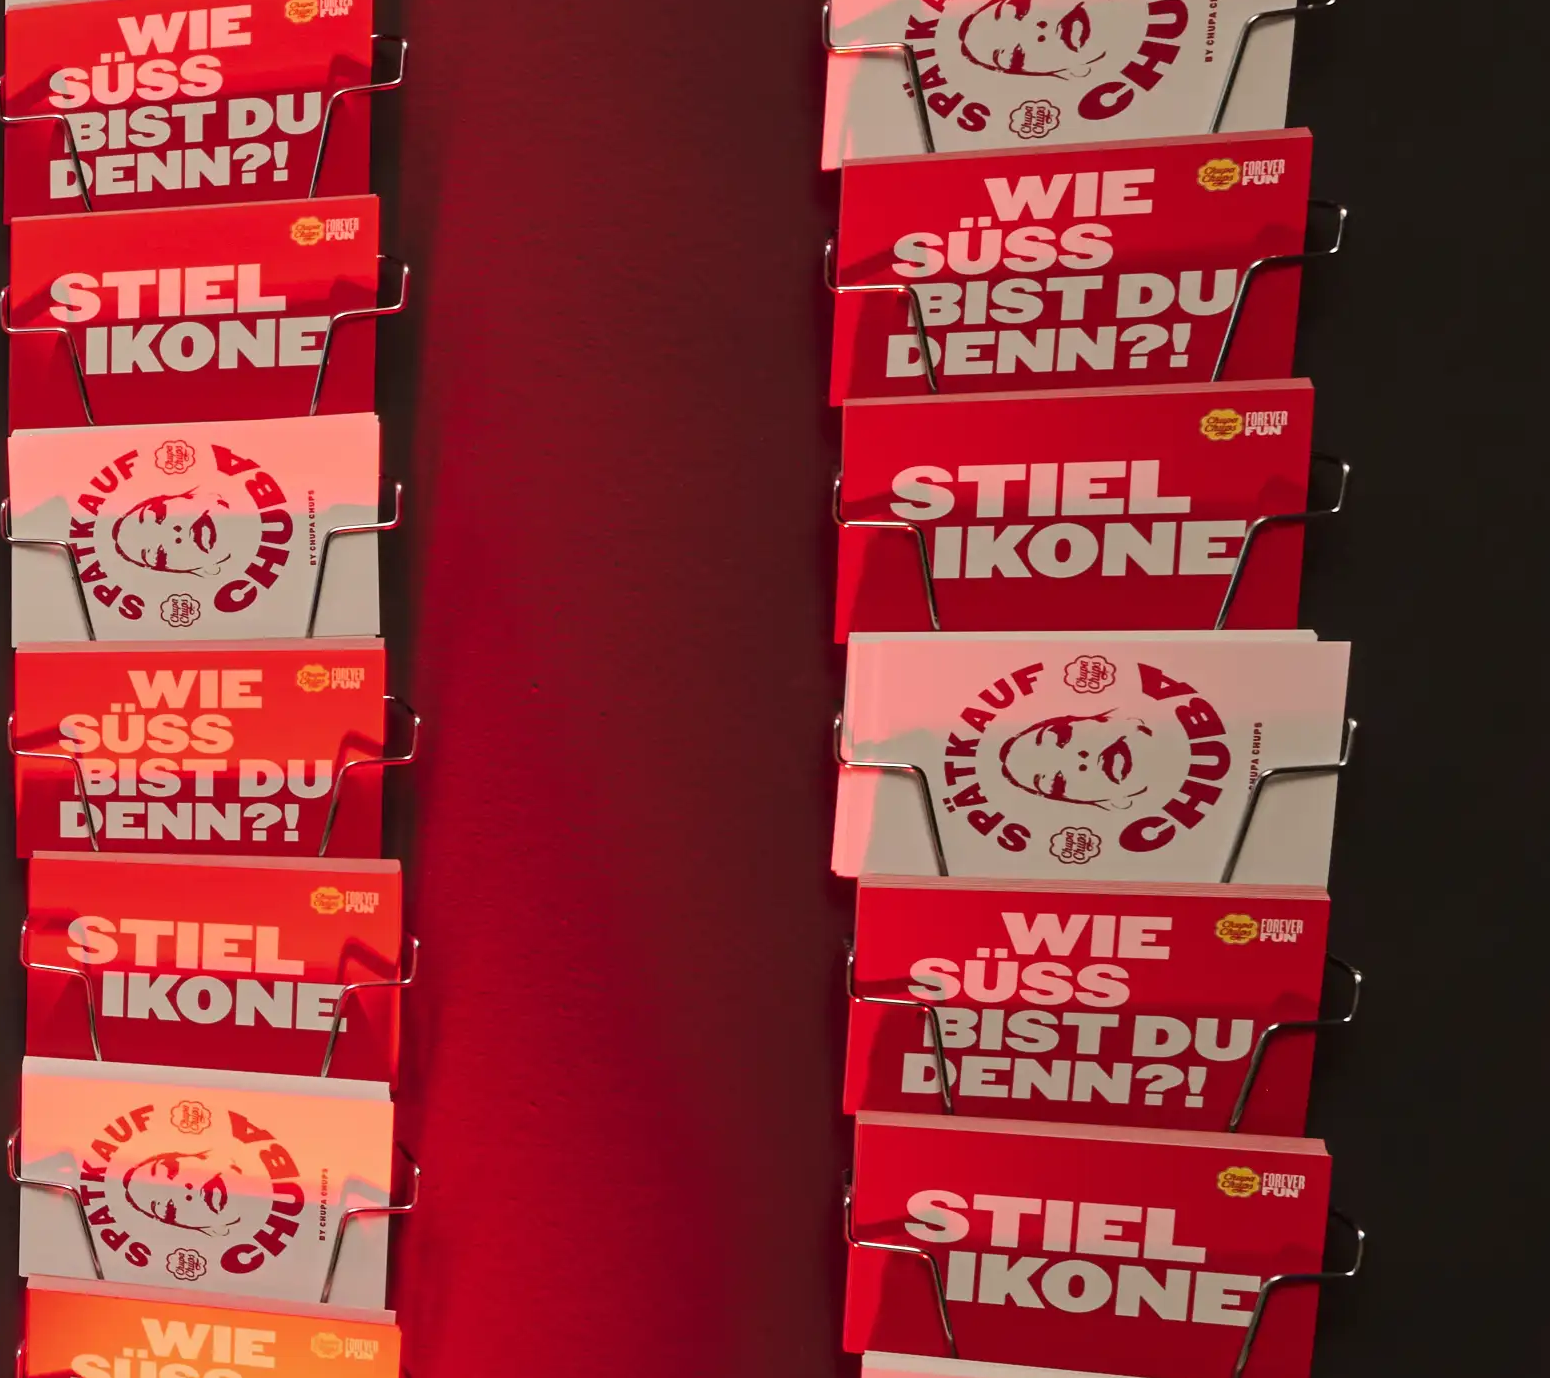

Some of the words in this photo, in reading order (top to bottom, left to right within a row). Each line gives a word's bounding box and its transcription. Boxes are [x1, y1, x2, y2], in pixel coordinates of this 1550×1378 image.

[118, 4, 252, 57] WIE
[49, 53, 222, 109] SÜSS
[64, 103, 220, 154] BIST
[229, 91, 322, 138] DU
[50, 143, 289, 200] DENN?!
[984, 168, 1155, 222] WIE
[1242, 173, 1279, 186] FUN
[1243, 159, 1285, 176] FOREVER
[892, 216, 1114, 278] SÜSS
[50, 263, 287, 323] STIEL
[908, 275, 1103, 327] BIST
[1116, 268, 1238, 319] DU
[86, 317, 330, 375] IKONE
[886, 322, 1192, 378] DENN?!
[890, 459, 1192, 521] STIEL
[210, 444, 293, 613] CHUBA
[933, 519, 1248, 579] IKONE
[944, 662, 1045, 852] SPÄTKAUF
[1118, 663, 1232, 853] CHUBA
[1261, 1186, 1300, 1198] FUN
[1262, 1172, 1306, 1190] FOREVER
[904, 1189, 1207, 1265] STIEL
[946, 1250, 1262, 1328] IKONE
[142, 1318, 277, 1368] WIE
